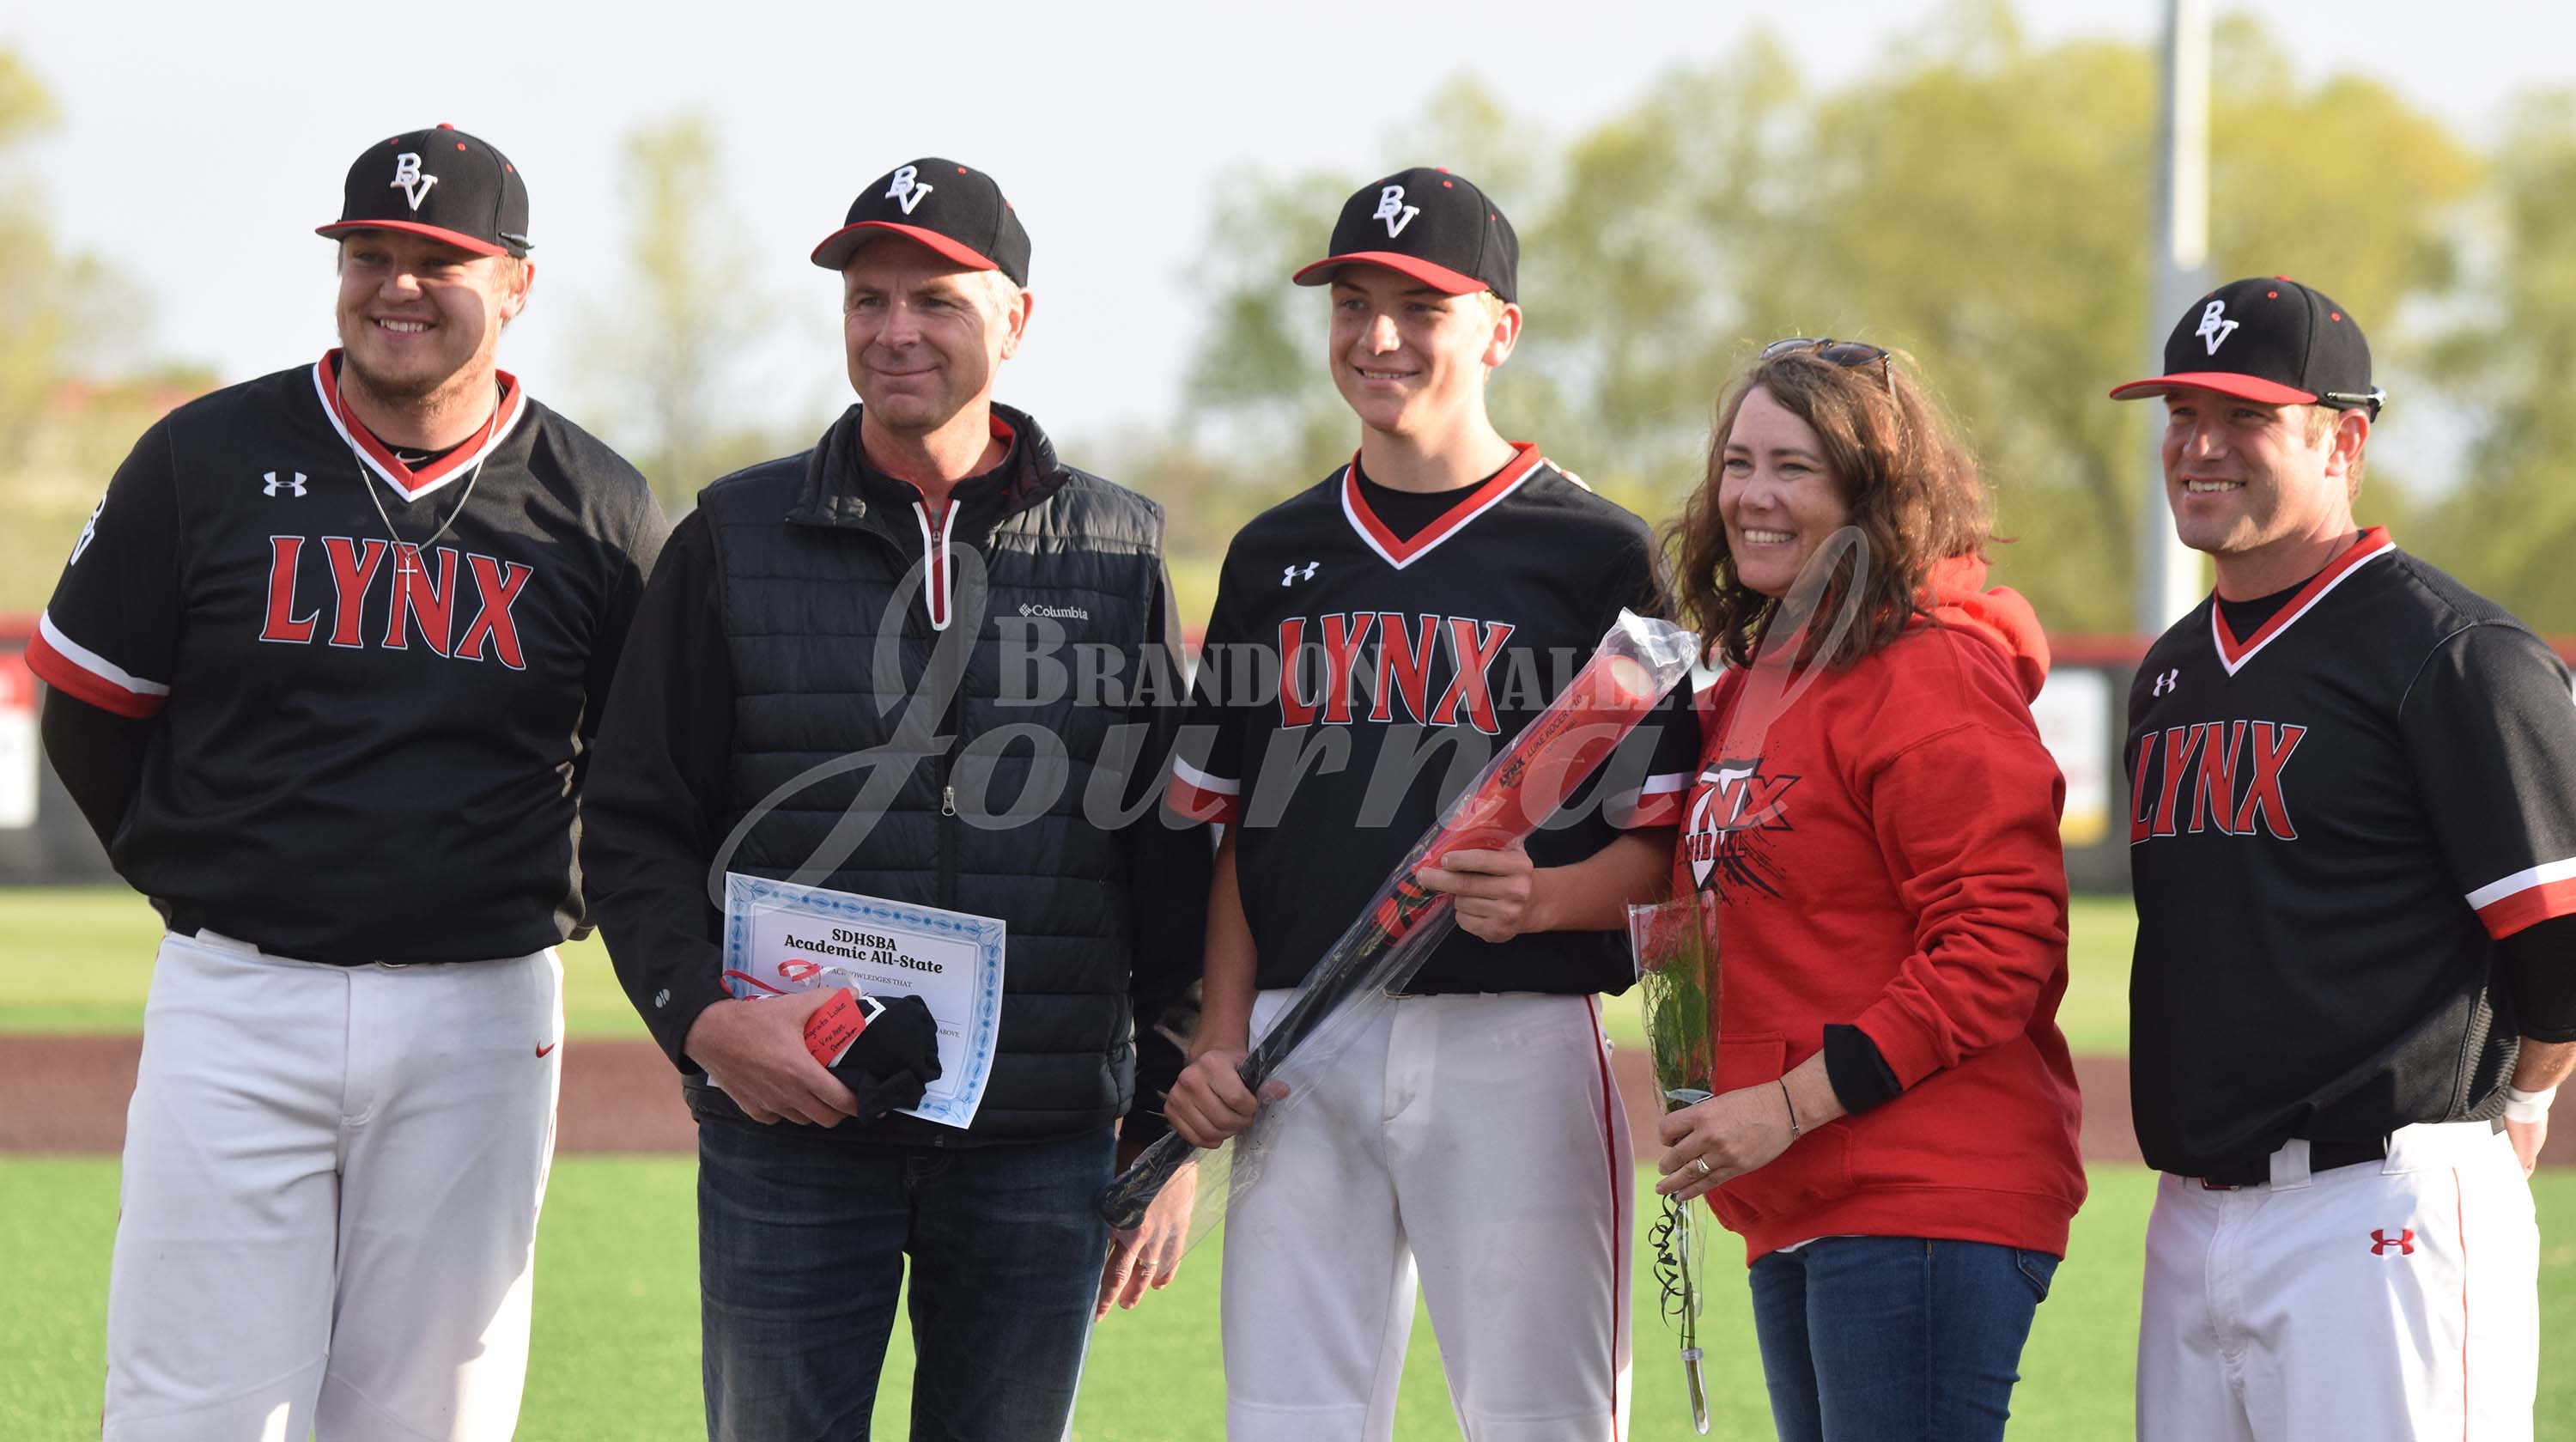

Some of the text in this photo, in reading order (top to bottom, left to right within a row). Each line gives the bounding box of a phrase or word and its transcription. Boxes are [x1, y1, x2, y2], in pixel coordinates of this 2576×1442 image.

[390, 152, 439, 212] BV
[885, 165, 934, 216] BV
[1373, 185, 1420, 239] BV
[2195, 300, 2239, 356] BV
[259, 535, 533, 671] LYNX
[1032, 605, 1089, 620] Columbia
[1279, 611, 1516, 735] LYNX
[1527, 733, 1546, 758] LUKE
[2129, 720, 2308, 847] LYNX
[1675, 829, 1746, 862] ASEBALL
[784, 934, 944, 974] Academic All-State
[831, 928, 897, 951] SDHSBA
[831, 968, 914, 989] ACKOWLEDGES THAT
[827, 1002, 847, 1019] Luke
[938, 1028, 961, 1038] ABOVE
